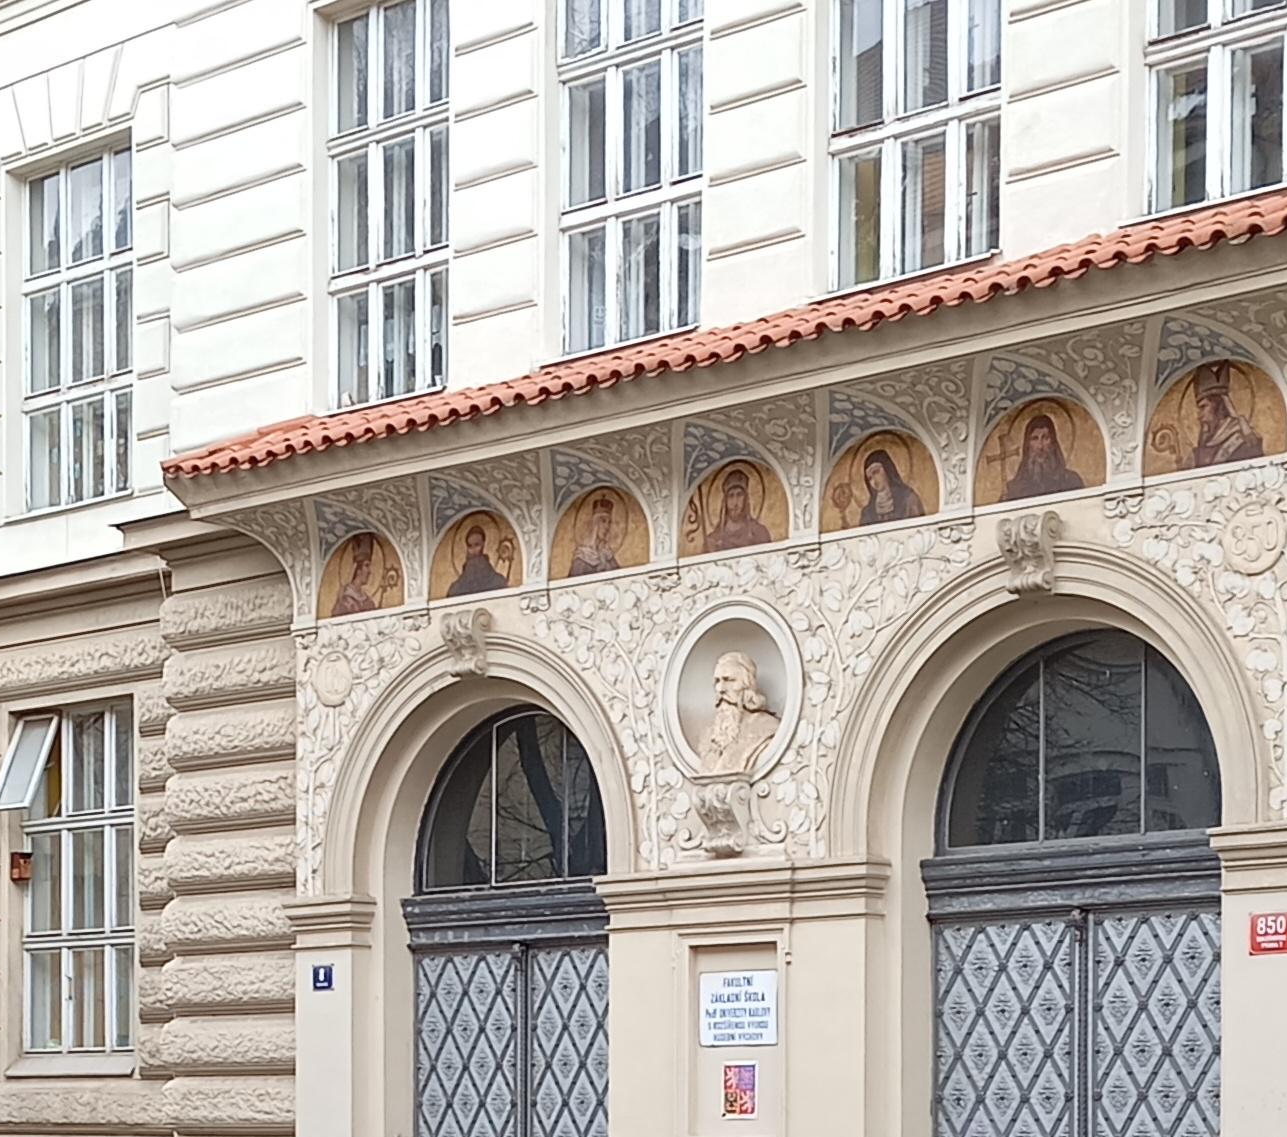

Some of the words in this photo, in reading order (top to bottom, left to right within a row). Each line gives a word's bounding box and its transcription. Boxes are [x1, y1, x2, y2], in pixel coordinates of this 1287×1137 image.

[1231, 517, 1279, 562] 850
[1256, 916, 1286, 934] 850
[711, 990, 742, 1004] ZÁKLADNÍ
[744, 990, 765, 1002] ŠKOLA
